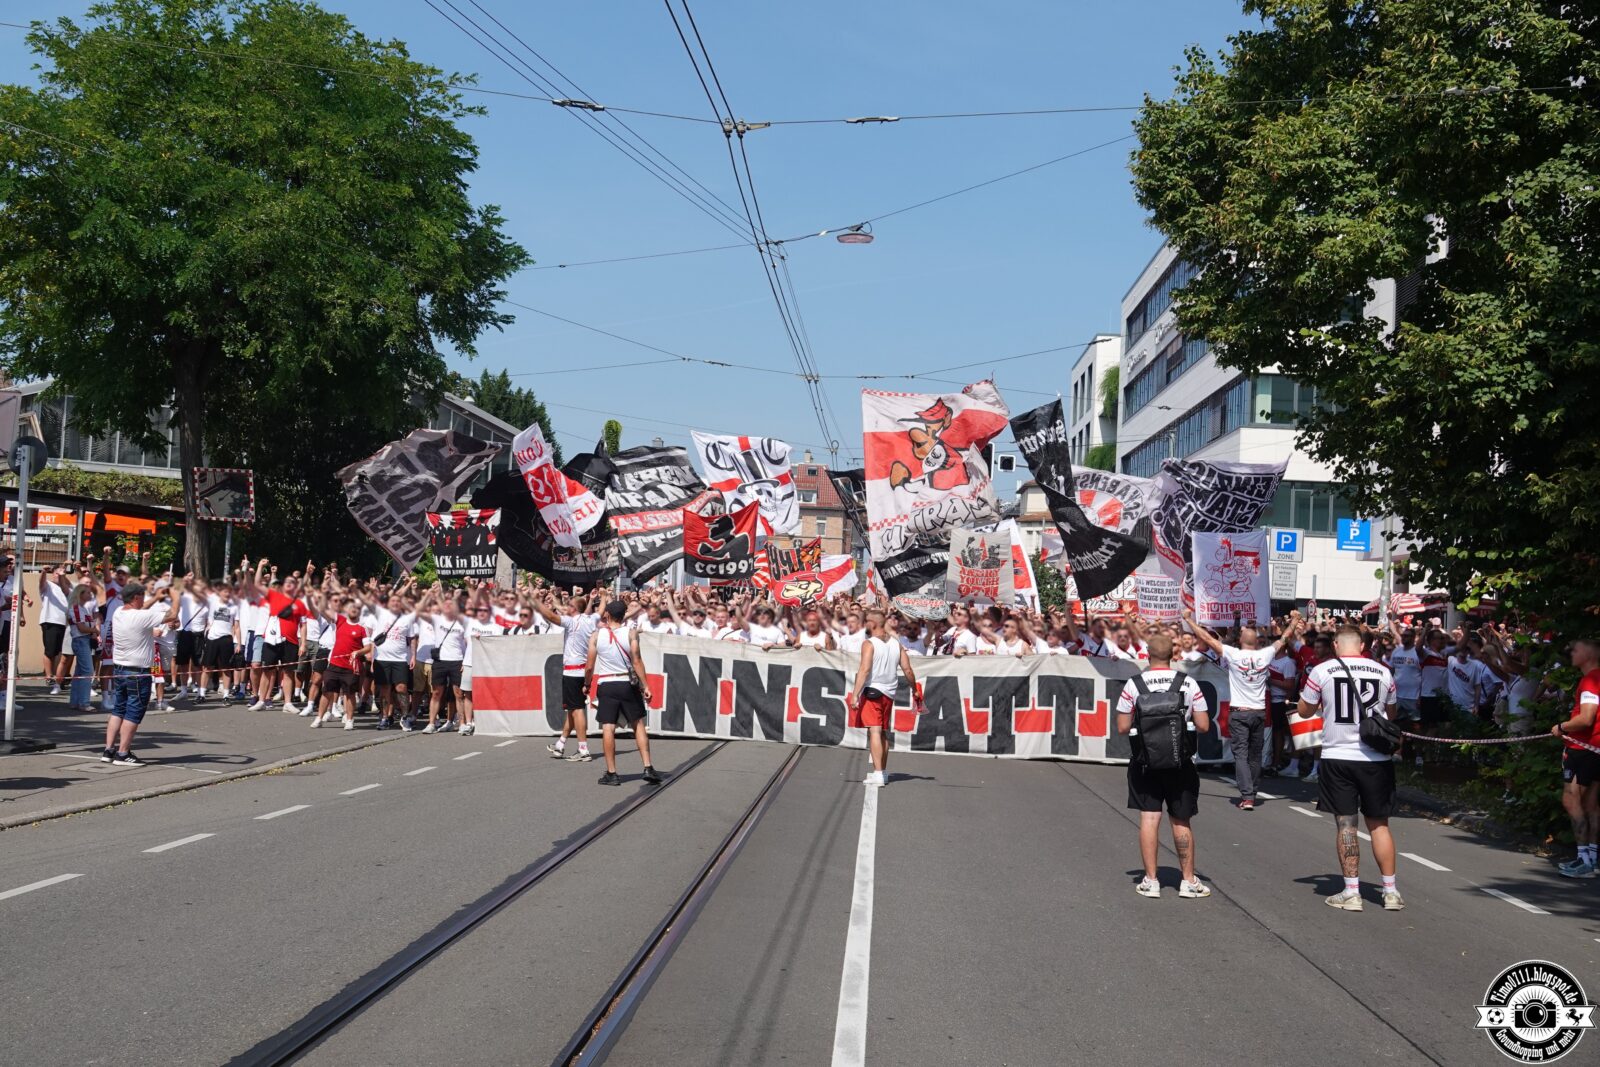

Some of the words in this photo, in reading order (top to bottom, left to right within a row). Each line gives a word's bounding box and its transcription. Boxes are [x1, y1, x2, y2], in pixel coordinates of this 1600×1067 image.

[1350, 527, 1360, 540] P
[1281, 534, 1292, 549] P
[455, 555, 467, 568] in
[959, 566, 1000, 577] ANGRY
[959, 575, 1000, 586] YOUTH
[1327, 665, 1383, 676] SCHWBENSTURM
